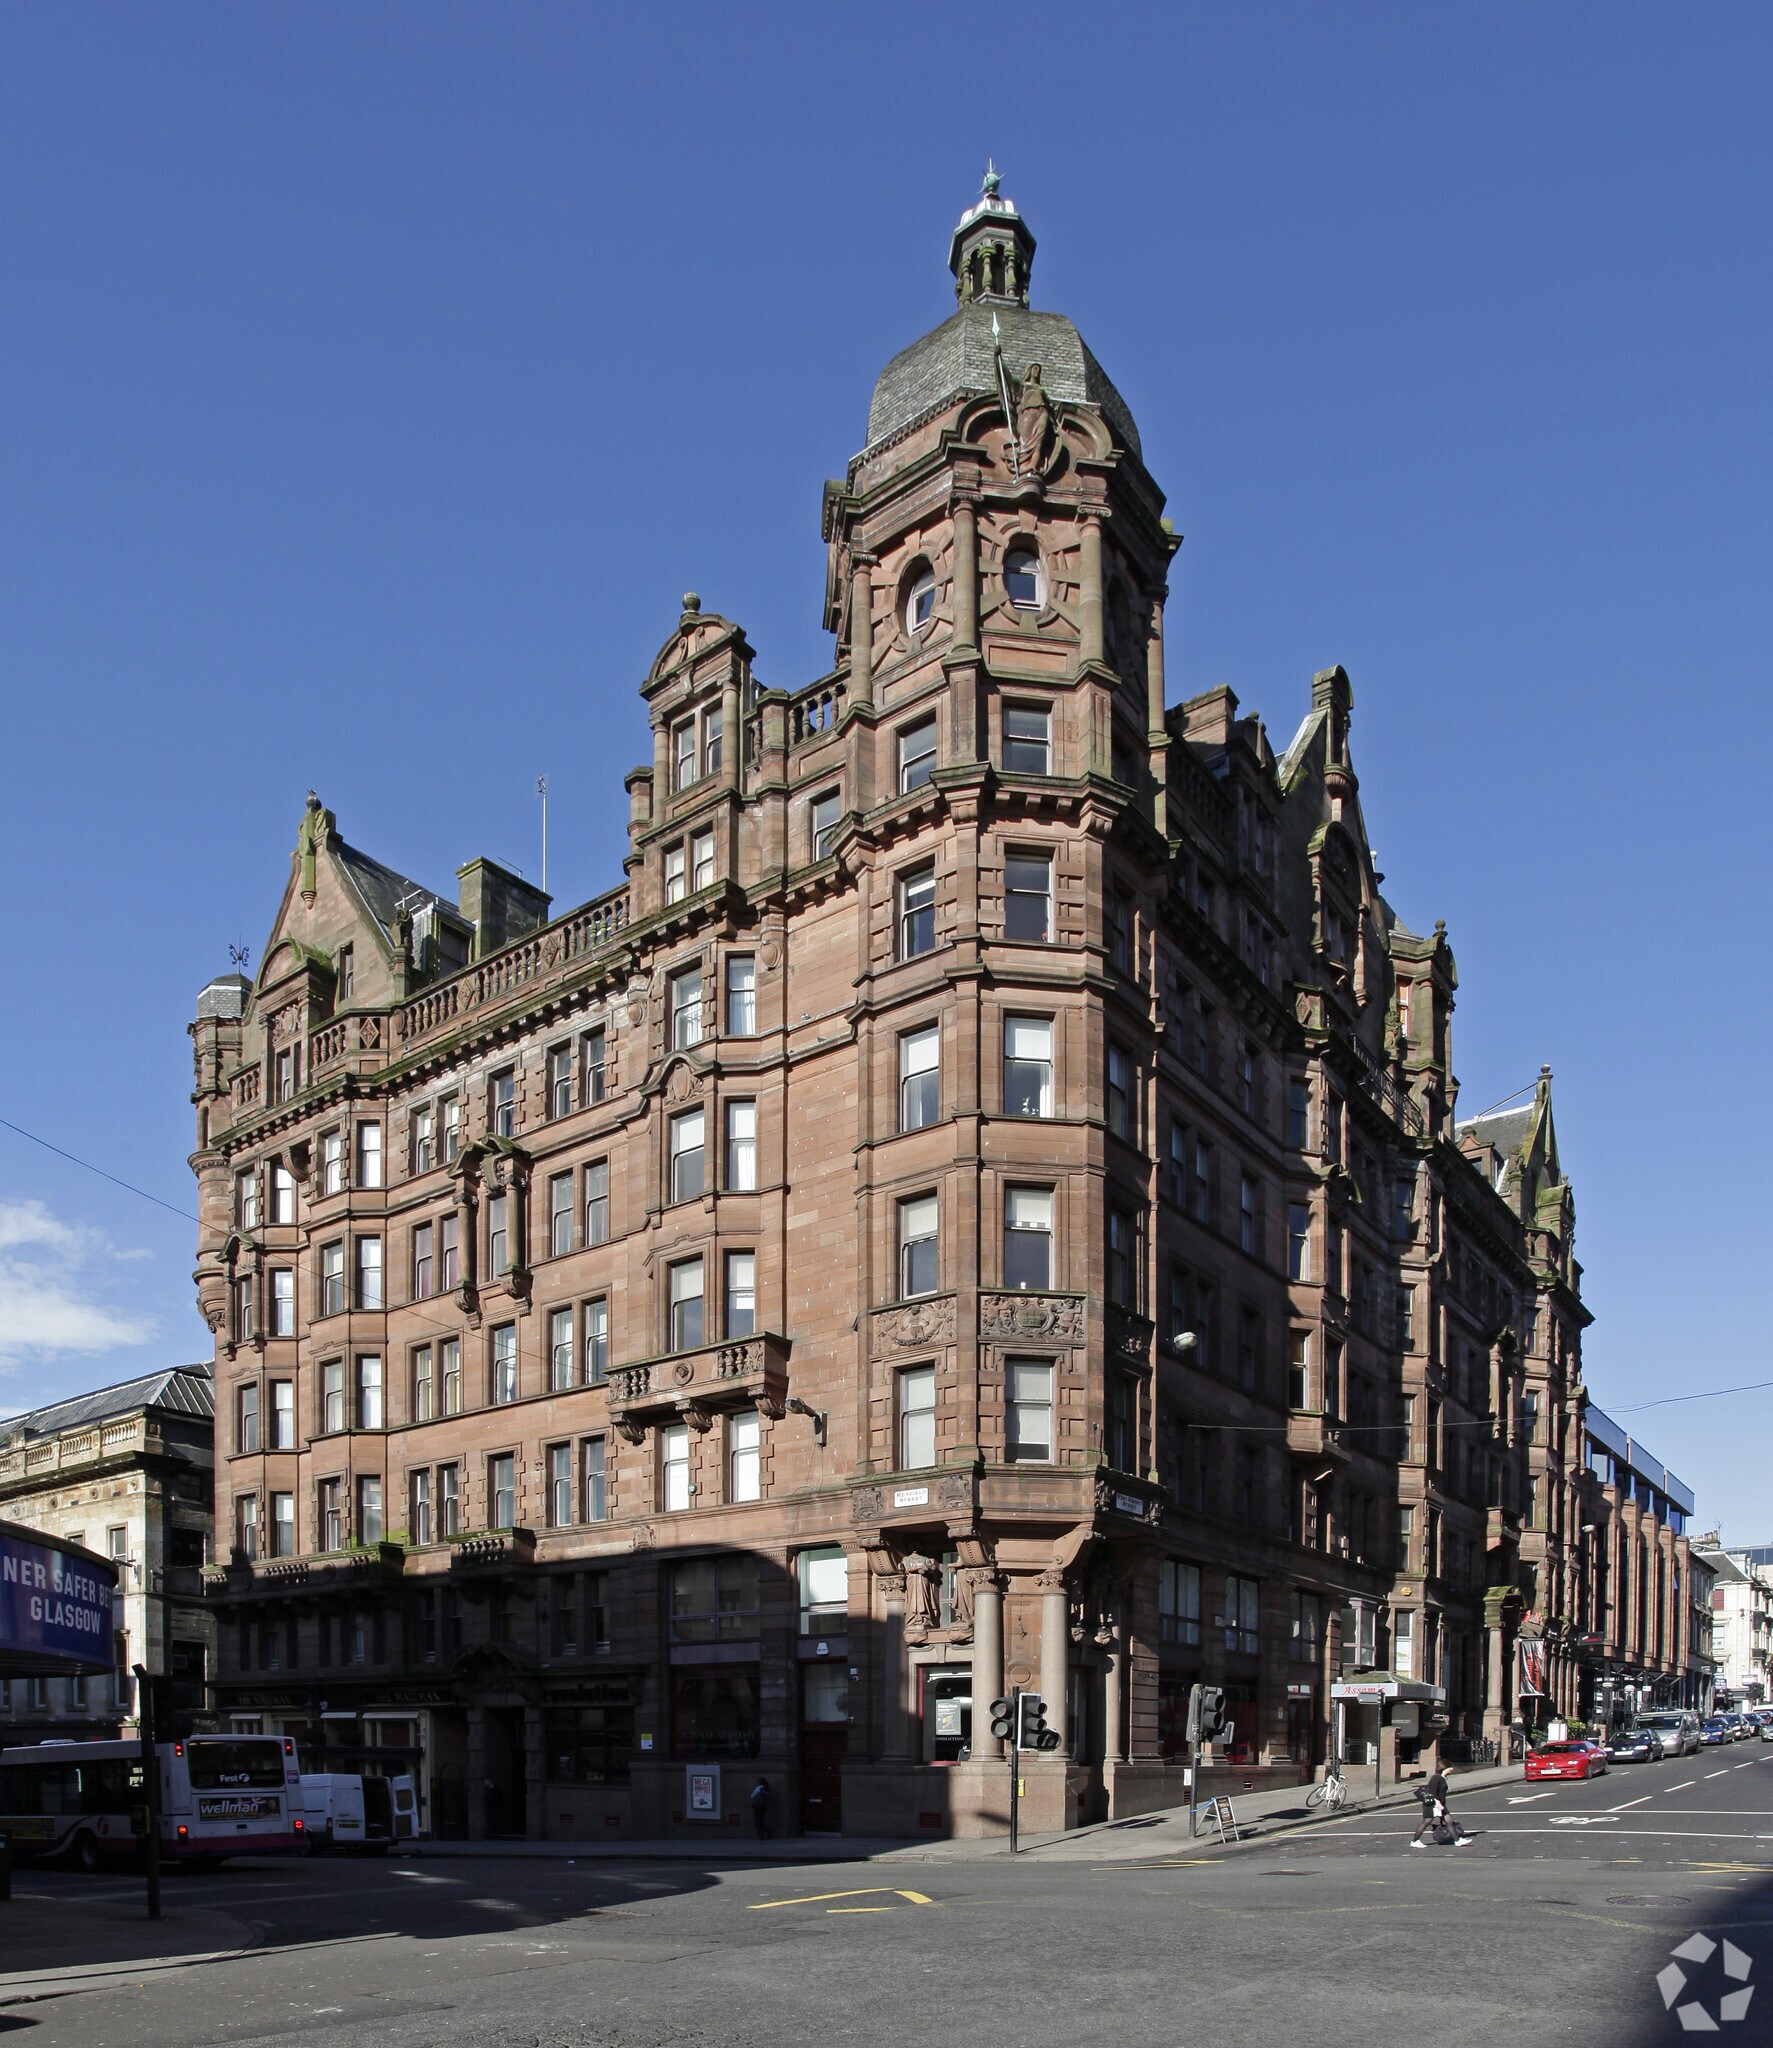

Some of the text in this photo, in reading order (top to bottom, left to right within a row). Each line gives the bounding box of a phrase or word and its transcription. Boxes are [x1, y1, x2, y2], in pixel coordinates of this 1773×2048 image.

[899, 1496, 923, 1504] STREET
[0, 1555, 46, 1589] NER
[53, 1568, 96, 1603] SAFER
[30, 1596, 101, 1634] GLASGOW
[219, 1774, 238, 1783] First
[200, 1800, 259, 1815] wellman
